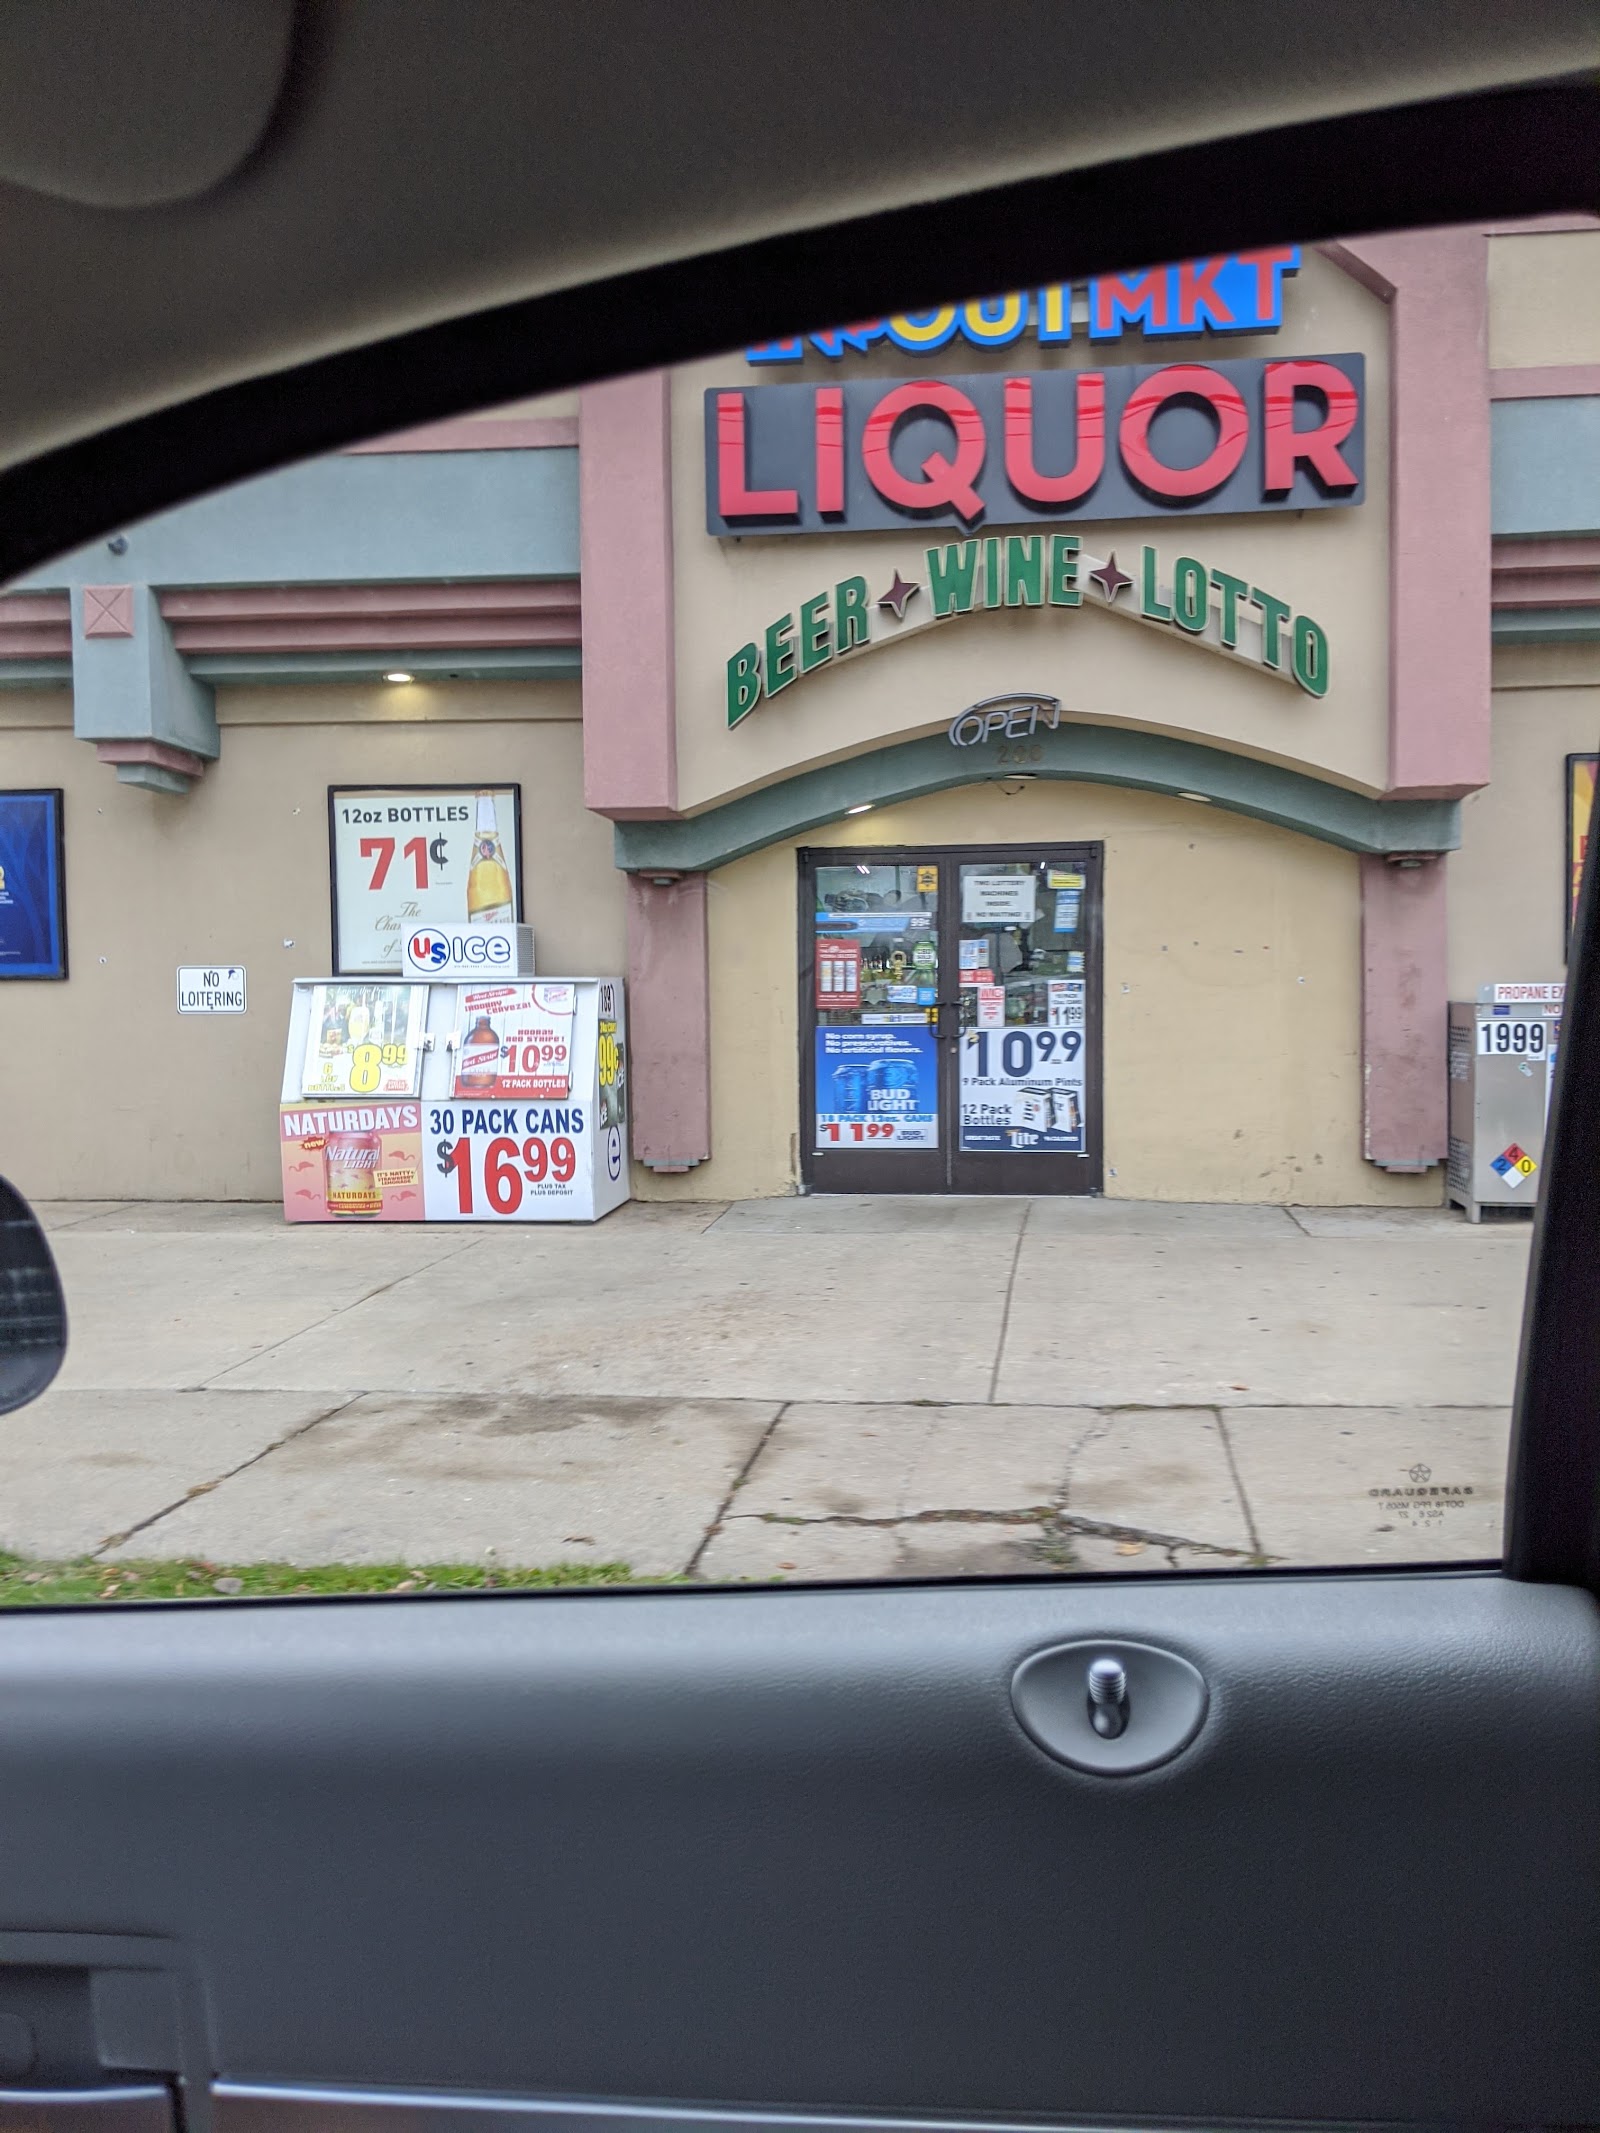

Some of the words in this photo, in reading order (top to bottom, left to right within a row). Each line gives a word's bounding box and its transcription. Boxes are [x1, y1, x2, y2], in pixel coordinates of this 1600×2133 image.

[1095, 246, 1296, 331] MKT
[717, 361, 1359, 520] LIQUOR
[924, 534, 1083, 618] WINE
[1139, 545, 1331, 699] LOTTO
[726, 575, 870, 730] BEER
[953, 698, 1061, 746] OPEN
[342, 809, 382, 824] 12oz
[387, 806, 470, 823] BOTTLES
[396, 902, 422, 918] The
[203, 971, 220, 988] NO
[181, 991, 243, 1007] LOITERING
[1498, 986, 1549, 999] PROPANE
[1544, 1004, 1561, 1015] NO
[1481, 1023, 1544, 1054] 1999
[501, 1079, 511, 1089] 12
[511, 1079, 532, 1089] PACK
[533, 1078, 566, 1089] BOTTLES
[971, 1078, 997, 1086] Pack
[998, 1078, 1053, 1086] Aluminum
[1055, 1078, 1083, 1086] Pints
[870, 1089, 911, 1100] BUD
[867, 1100, 921, 1111] LIGHT
[961, 1104, 978, 1115] 12
[980, 1104, 1013, 1115] Pack
[283, 1105, 418, 1136] NATURDAYS
[430, 1109, 455, 1135] 30
[461, 1108, 519, 1134] PACK
[525, 1108, 585, 1134] CANS
[963, 1114, 1011, 1126] Bottles
[303, 1139, 326, 1150] new
[325, 1145, 381, 1161] Natural
[1507, 1147, 1519, 1161] 4
[343, 1160, 378, 1169] LIGHT
[1497, 1158, 1506, 1171] 2
[1521, 1159, 1531, 1173] 0
[436, 1136, 577, 1216] $1699
[332, 1191, 377, 1199] NATURDAYS
